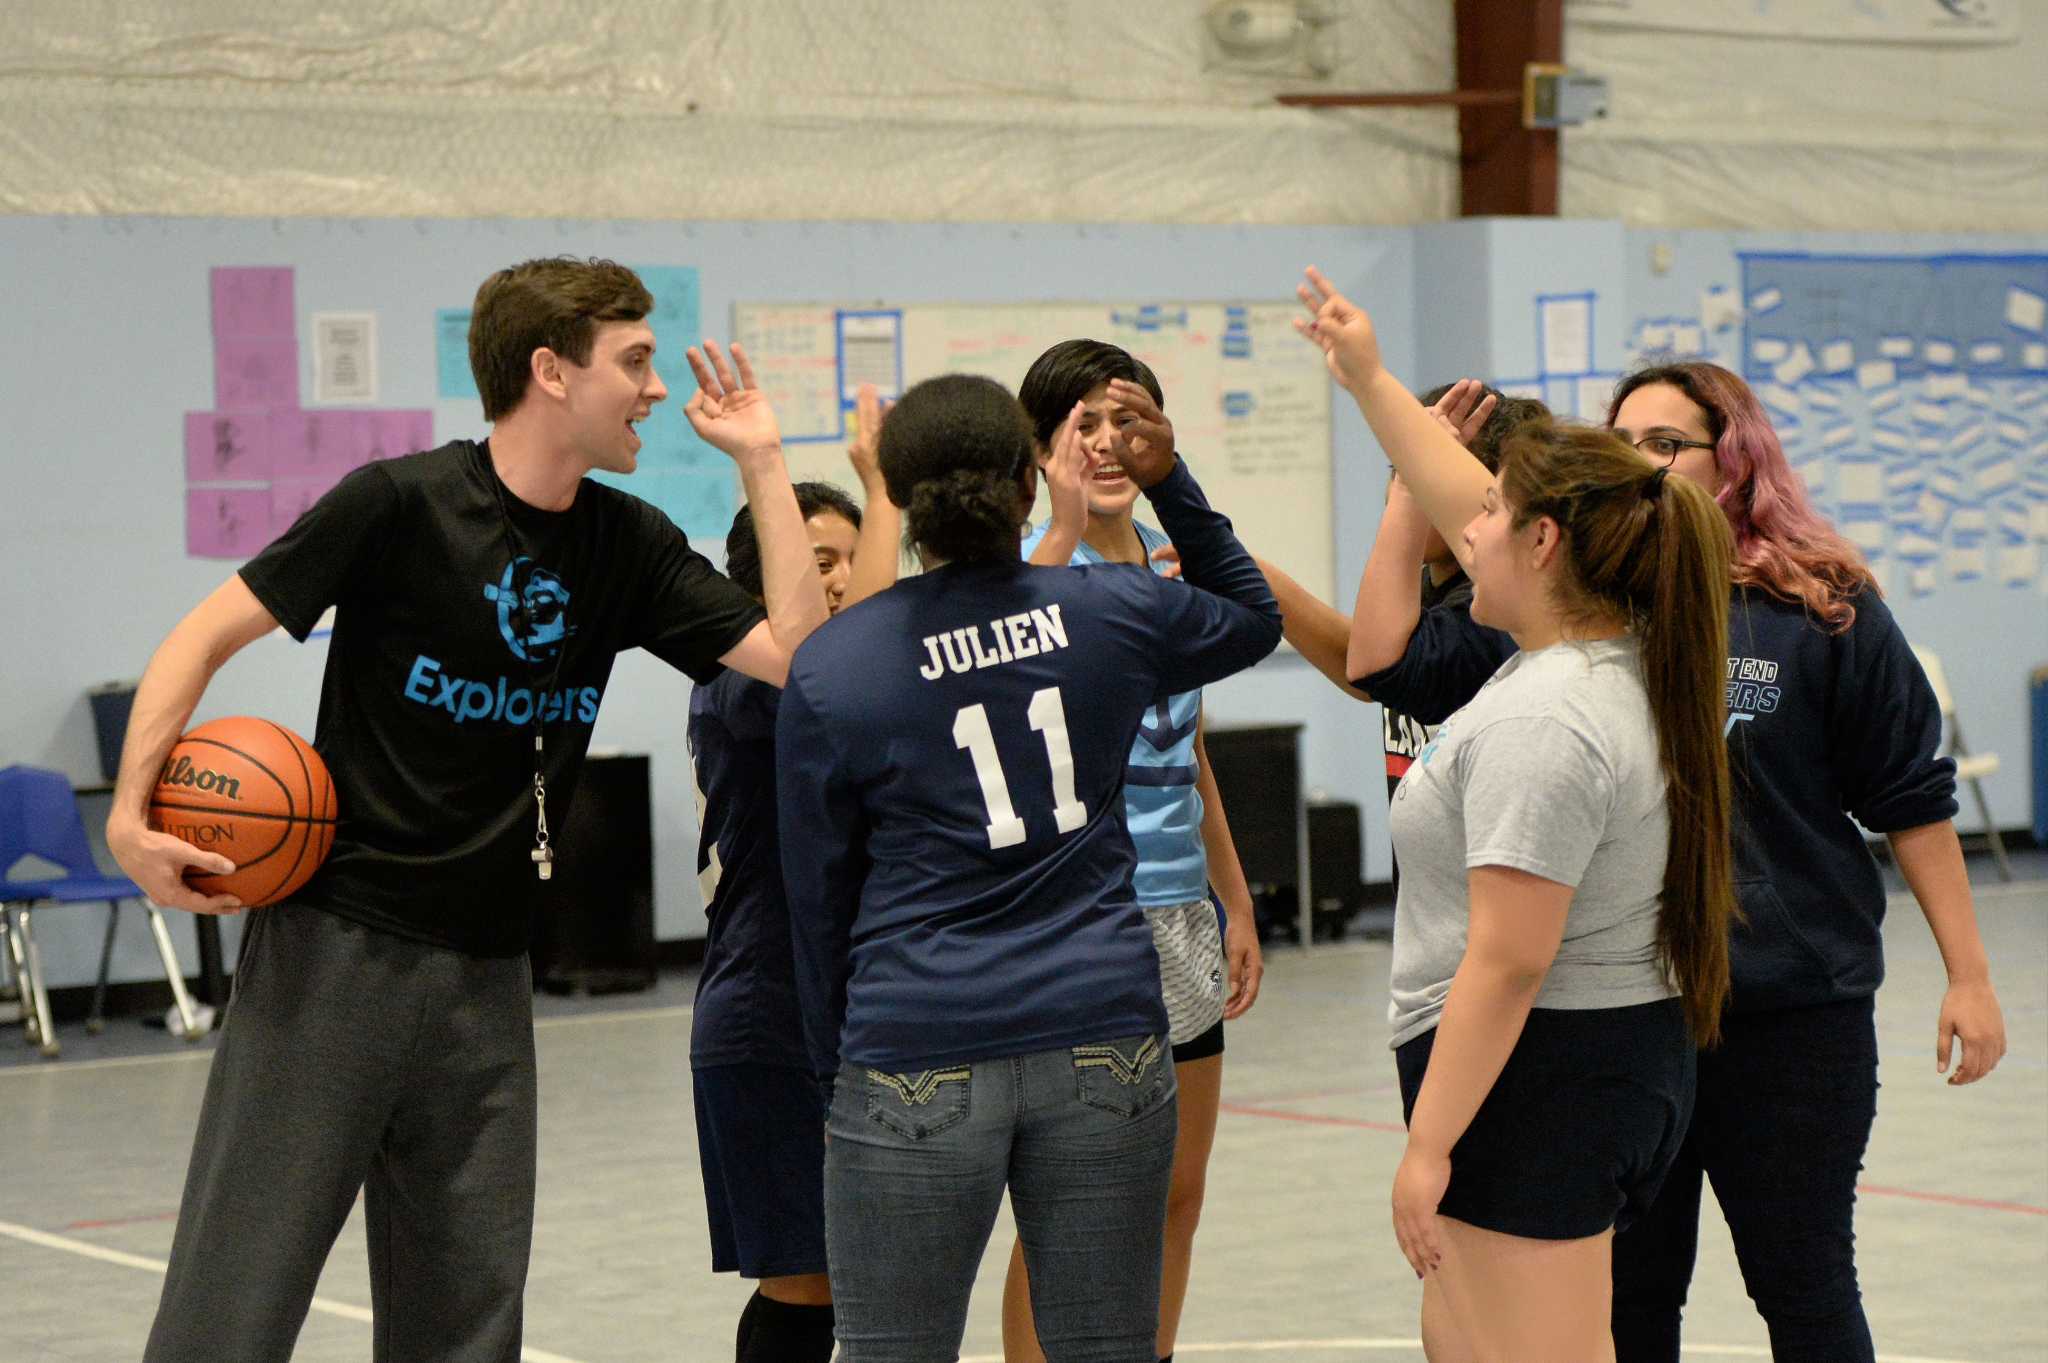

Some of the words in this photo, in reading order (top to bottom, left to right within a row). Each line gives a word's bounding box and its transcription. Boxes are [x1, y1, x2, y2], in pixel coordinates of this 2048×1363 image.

[920, 603, 1069, 681] JULIEN
[1740, 657, 1778, 683] END
[1724, 681, 1781, 713] ERS
[161, 755, 240, 800] ilson
[952, 686, 1087, 850] 11
[168, 822, 235, 844] UTION
